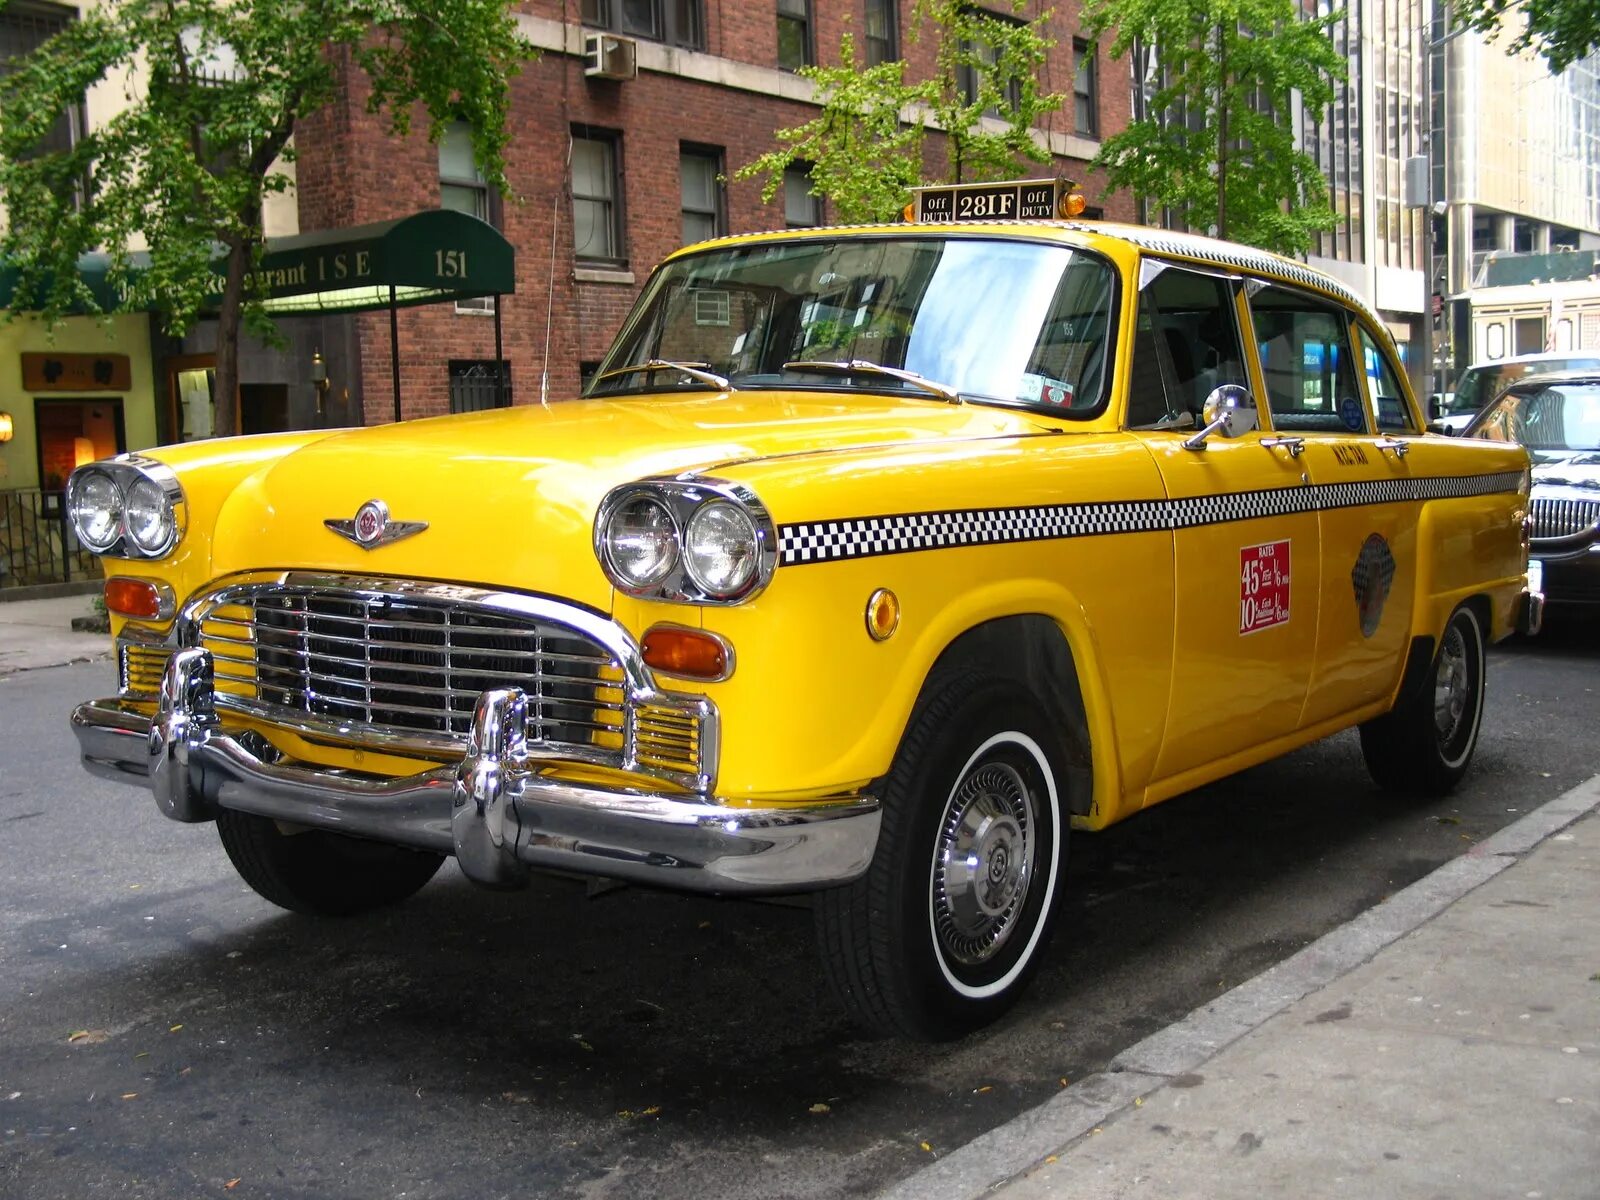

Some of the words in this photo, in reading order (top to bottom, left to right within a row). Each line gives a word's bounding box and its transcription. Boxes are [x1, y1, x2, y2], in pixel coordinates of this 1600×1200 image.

[922, 211, 952, 223] DUTY
[1021, 204, 1052, 218] DUTY
[435, 249, 468, 278] 151
